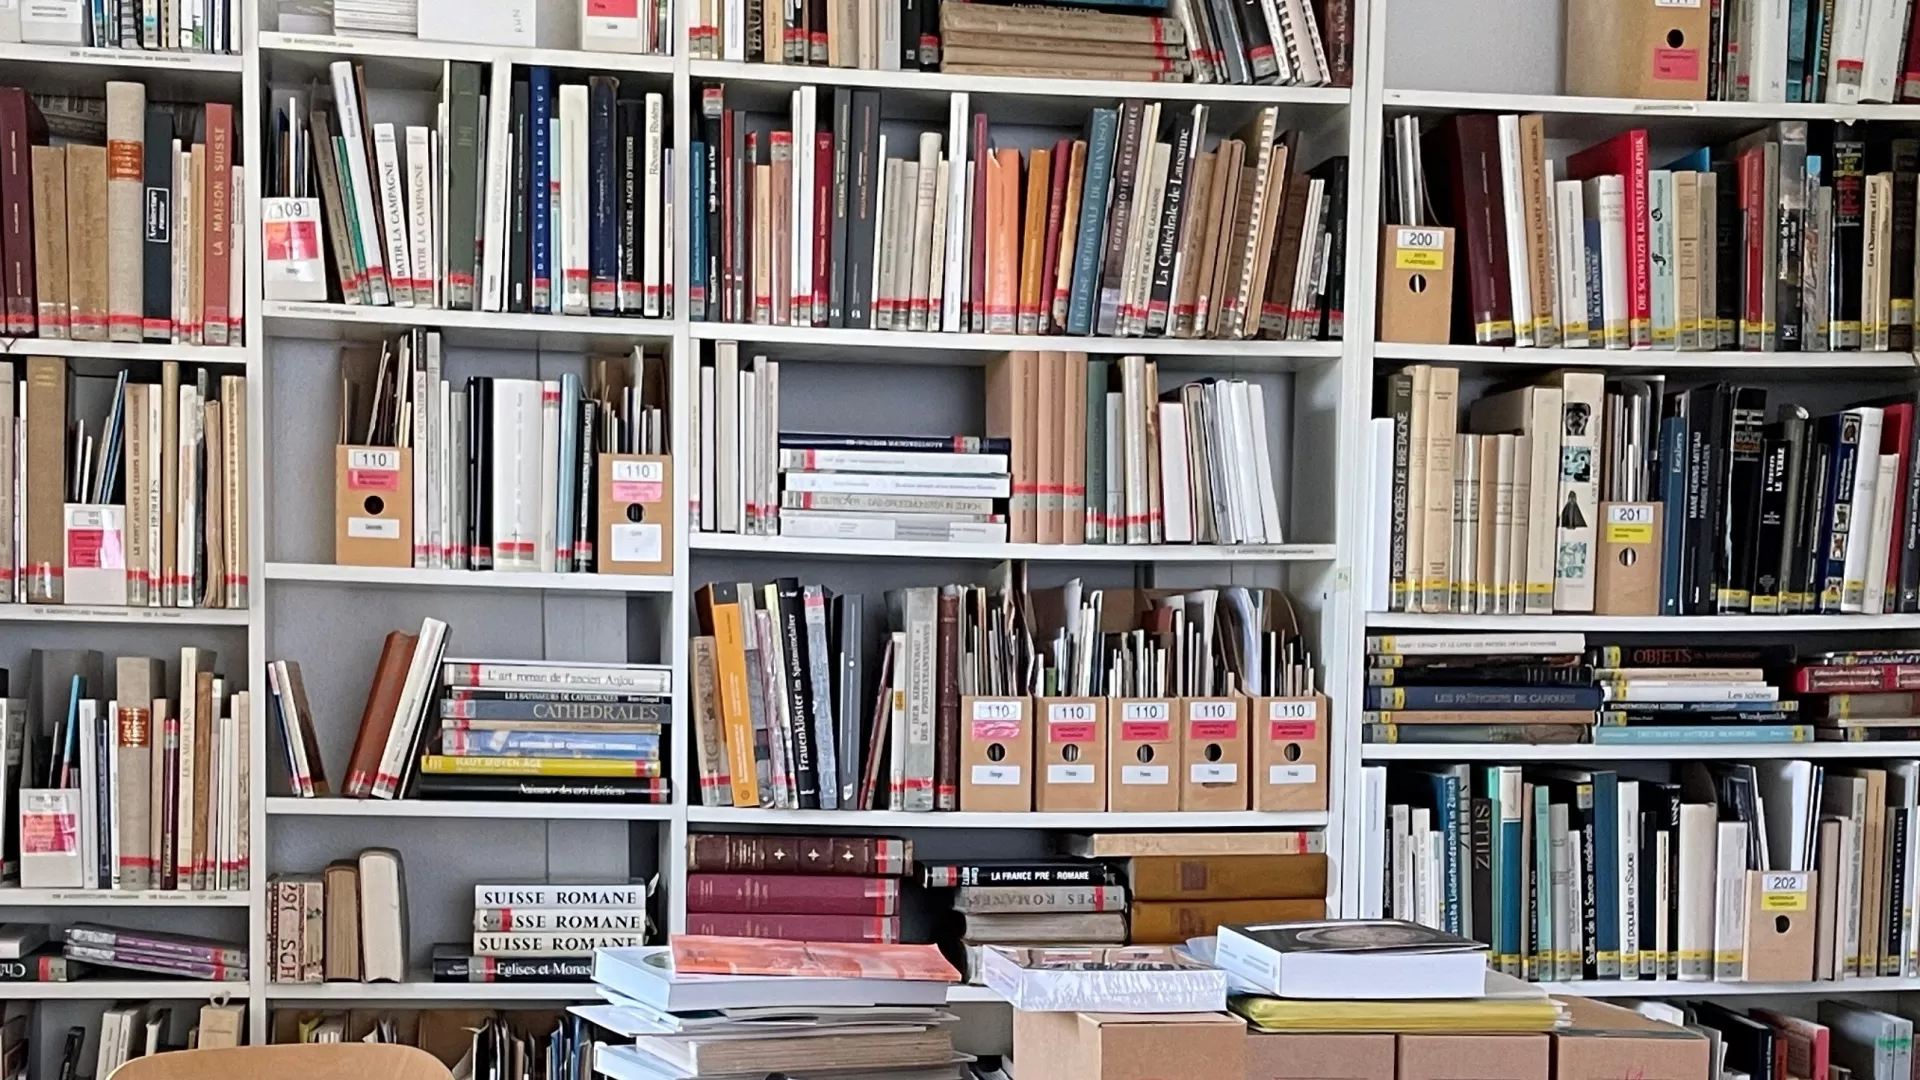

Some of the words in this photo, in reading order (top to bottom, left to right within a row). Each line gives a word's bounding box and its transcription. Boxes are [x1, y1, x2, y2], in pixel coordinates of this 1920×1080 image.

[214, 126, 225, 172] SUISSE
[1168, 128, 1190, 185] Lausanne
[384, 161, 400, 225] CAMPAGNE
[413, 163, 425, 226] CAMPAGNE
[1167, 187, 1181, 203] de
[213, 181, 224, 232] MAISON
[1112, 169, 1130, 251] ROMAINMÔTIER
[392, 228, 402, 242] LA
[416, 229, 426, 243] LA
[1158, 204, 1179, 268] Cathédrale
[1409, 232, 1433, 246] 200
[213, 241, 224, 256] LA
[393, 245, 406, 277] BATIR
[417, 247, 427, 278] BATIR
[1636, 234, 1646, 291] SCHWEIZER
[1155, 270, 1169, 286] La
[1637, 293, 1646, 311] DIE
[1396, 411, 1408, 467] BRETAGNE
[364, 453, 387, 467] 110
[1775, 447, 1785, 477] VERRE
[626, 465, 650, 479] 110
[1396, 469, 1406, 484] DE
[1774, 481, 1783, 492] LE
[1619, 507, 1640, 521] 201
[1393, 535, 1405, 577] PIERRES
[1633, 648, 1693, 665] OBJETS
[498, 672, 513, 682] art
[516, 673, 548, 683] roman
[550, 672, 562, 682] de
[606, 673, 635, 688] Anjou
[792, 679, 803, 692] im
[560, 693, 570, 701] DE
[1434, 693, 1453, 703] LES
[1513, 693, 1527, 703] DE
[1727, 690, 1743, 700] Les
[533, 703, 660, 721] CATHEDRALES
[988, 705, 1010, 717] 110
[1061, 706, 1084, 719] 110
[1136, 706, 1157, 718] 110
[1203, 705, 1225, 718] 110
[1283, 705, 1305, 717] 110
[793, 694, 810, 771] Frauenklöster
[1446, 778, 1457, 809] Zürich
[1447, 810, 1457, 819] in
[1475, 804, 1490, 869] ZILLIS
[1447, 820, 1459, 902] Liederhandschrift
[1624, 852, 1635, 883] Savoie
[991, 871, 1001, 881] LA
[1002, 871, 1033, 881] FRANCE
[1056, 870, 1090, 881] ROMANE
[1773, 876, 1796, 890] 202
[1583, 874, 1595, 906] Savoie
[1627, 884, 1635, 896] en
[484, 891, 546, 905] SUISSE
[557, 891, 638, 905] ROMANE
[1067, 893, 1100, 905] PES
[1449, 904, 1459, 937] sische
[1584, 908, 1595, 919] la
[556, 915, 641, 929] ROMANE
[1584, 920, 1596, 934] de
[479, 937, 543, 951] SUISSE
[552, 937, 638, 951] ROMANE
[497, 961, 536, 978] Eglises
[538, 963, 549, 975] et
